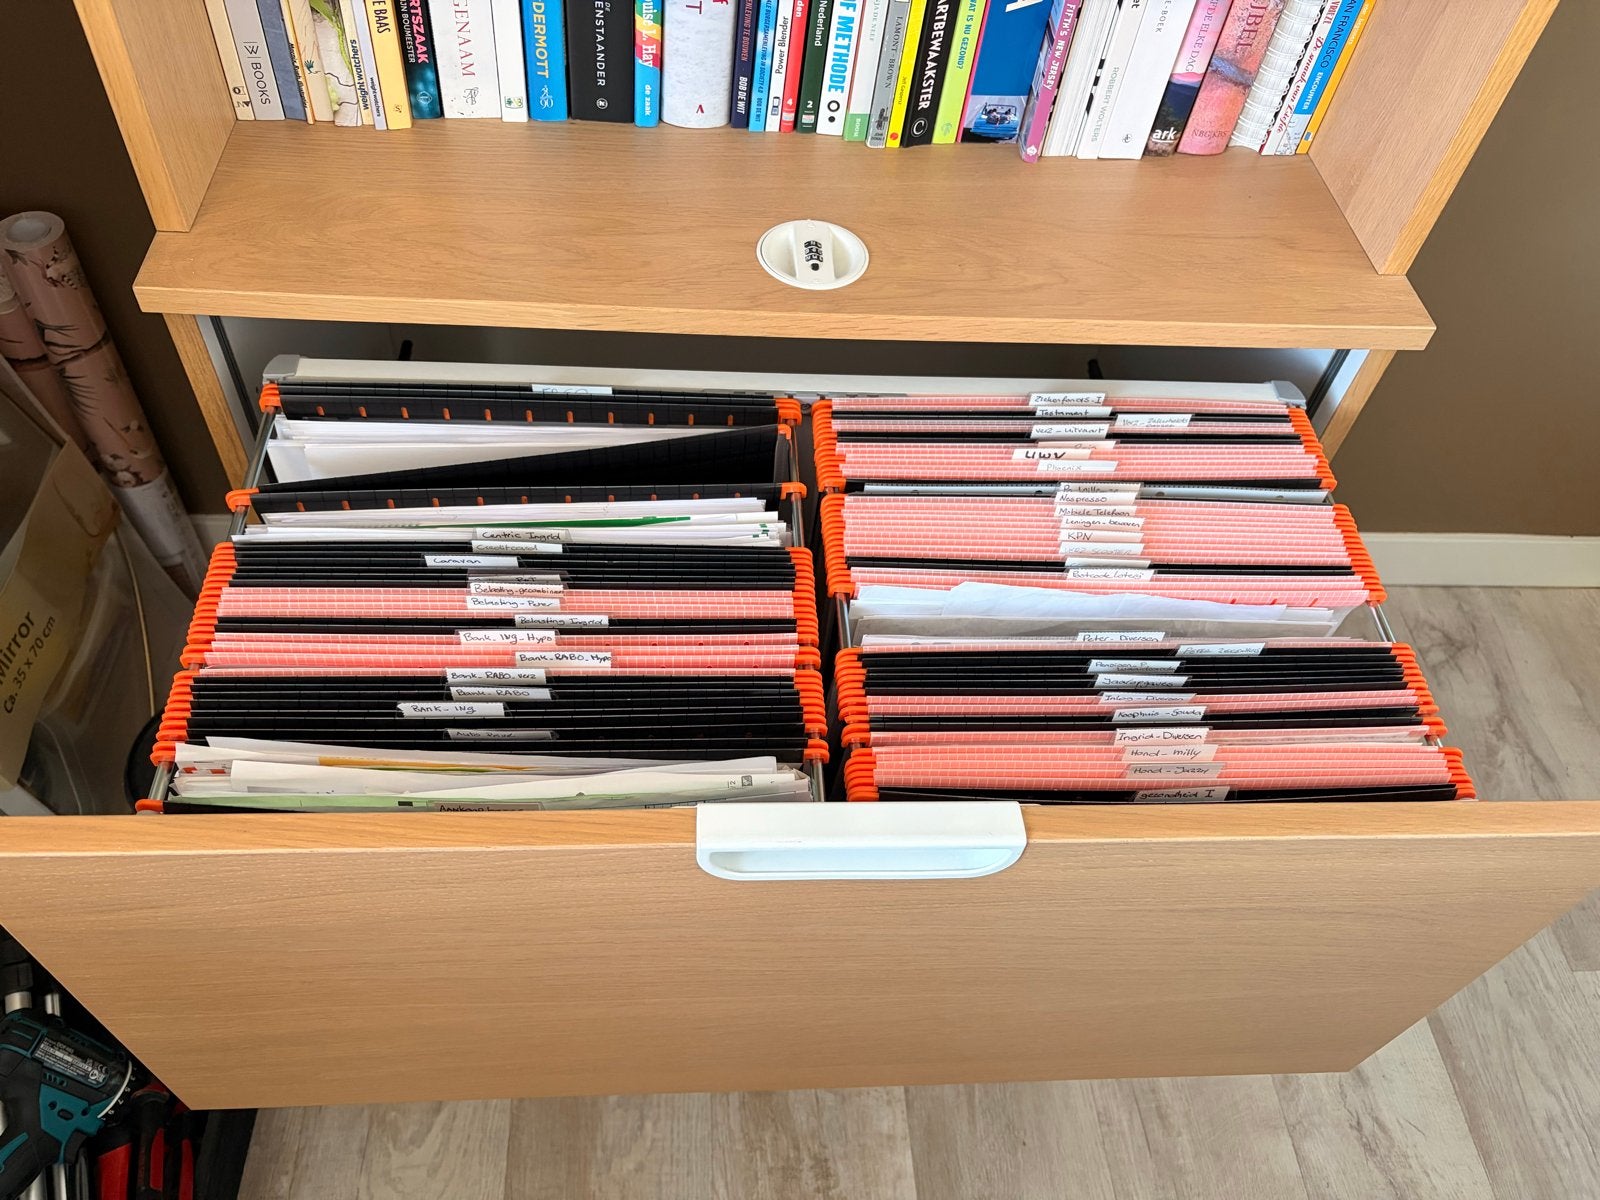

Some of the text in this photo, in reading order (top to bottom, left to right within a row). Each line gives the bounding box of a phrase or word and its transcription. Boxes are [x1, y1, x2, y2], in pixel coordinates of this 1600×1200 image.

[374, 9, 391, 34] BAAS
[642, 0, 657, 26] uise
[814, 1, 828, 47] Nederland
[964, 24, 972, 35] NU
[402, 14, 416, 63] BOUMEESTER
[532, 0, 549, 78] DERMOTT
[594, 1, 606, 87] ENSTAANDER
[775, 16, 789, 74] Power Blender
[1194, 23, 1210, 49] ELKE
[1320, 15, 1350, 69] FRANCISCO
[639, 44, 657, 67] Hay
[828, 0, 857, 94] F METHODE
[956, 37, 969, 70] GEZOND?
[1042, 3, 1076, 91] FIFTH'S NEW JERSEY
[1185, 50, 1200, 72] DAG
[1295, 52, 1316, 84] smaak
[250, 62, 271, 105] BOOKS
[349, 39, 370, 111] weight watchers
[1103, 66, 1119, 104] ROBBERT
[370, 77, 378, 97] weight
[736, 76, 748, 115] BOB DE WIT
[1290, 84, 1301, 103] van
[1302, 71, 1324, 110] ENCOUNTER
[644, 85, 652, 116] de zaak
[786, 98, 793, 106] 4
[806, 100, 813, 108] 2
[1152, 126, 1176, 140] ark
[1059, 493, 1108, 503] Nespresso
[1058, 508, 1130, 517] Mobiele Telefoon
[1065, 518, 1140, 528] Leningen bewaren
[481, 531, 561, 540] Centric Ingrid
[1067, 532, 1093, 541] KPN
[474, 583, 514, 594] Belasting
[471, 597, 518, 608] Belasting
[518, 616, 603, 626] Belasting Ingrid
[463, 632, 492, 642] Bank
[526, 632, 552, 643] Hypo
[1083, 634, 1159, 642] Peter Diversen
[3, 615, 56, 714] Ca. 35 x 70 cm
[519, 653, 612, 663] Bank RABO Hypo
[450, 671, 478, 679] Bank
[484, 671, 511, 680] RABO
[455, 688, 530, 697] Bank RABO
[1118, 710, 1160, 719] Koophuis
[1118, 731, 1202, 742] Ingrid Diversen
[1130, 749, 1160, 757] Hond
